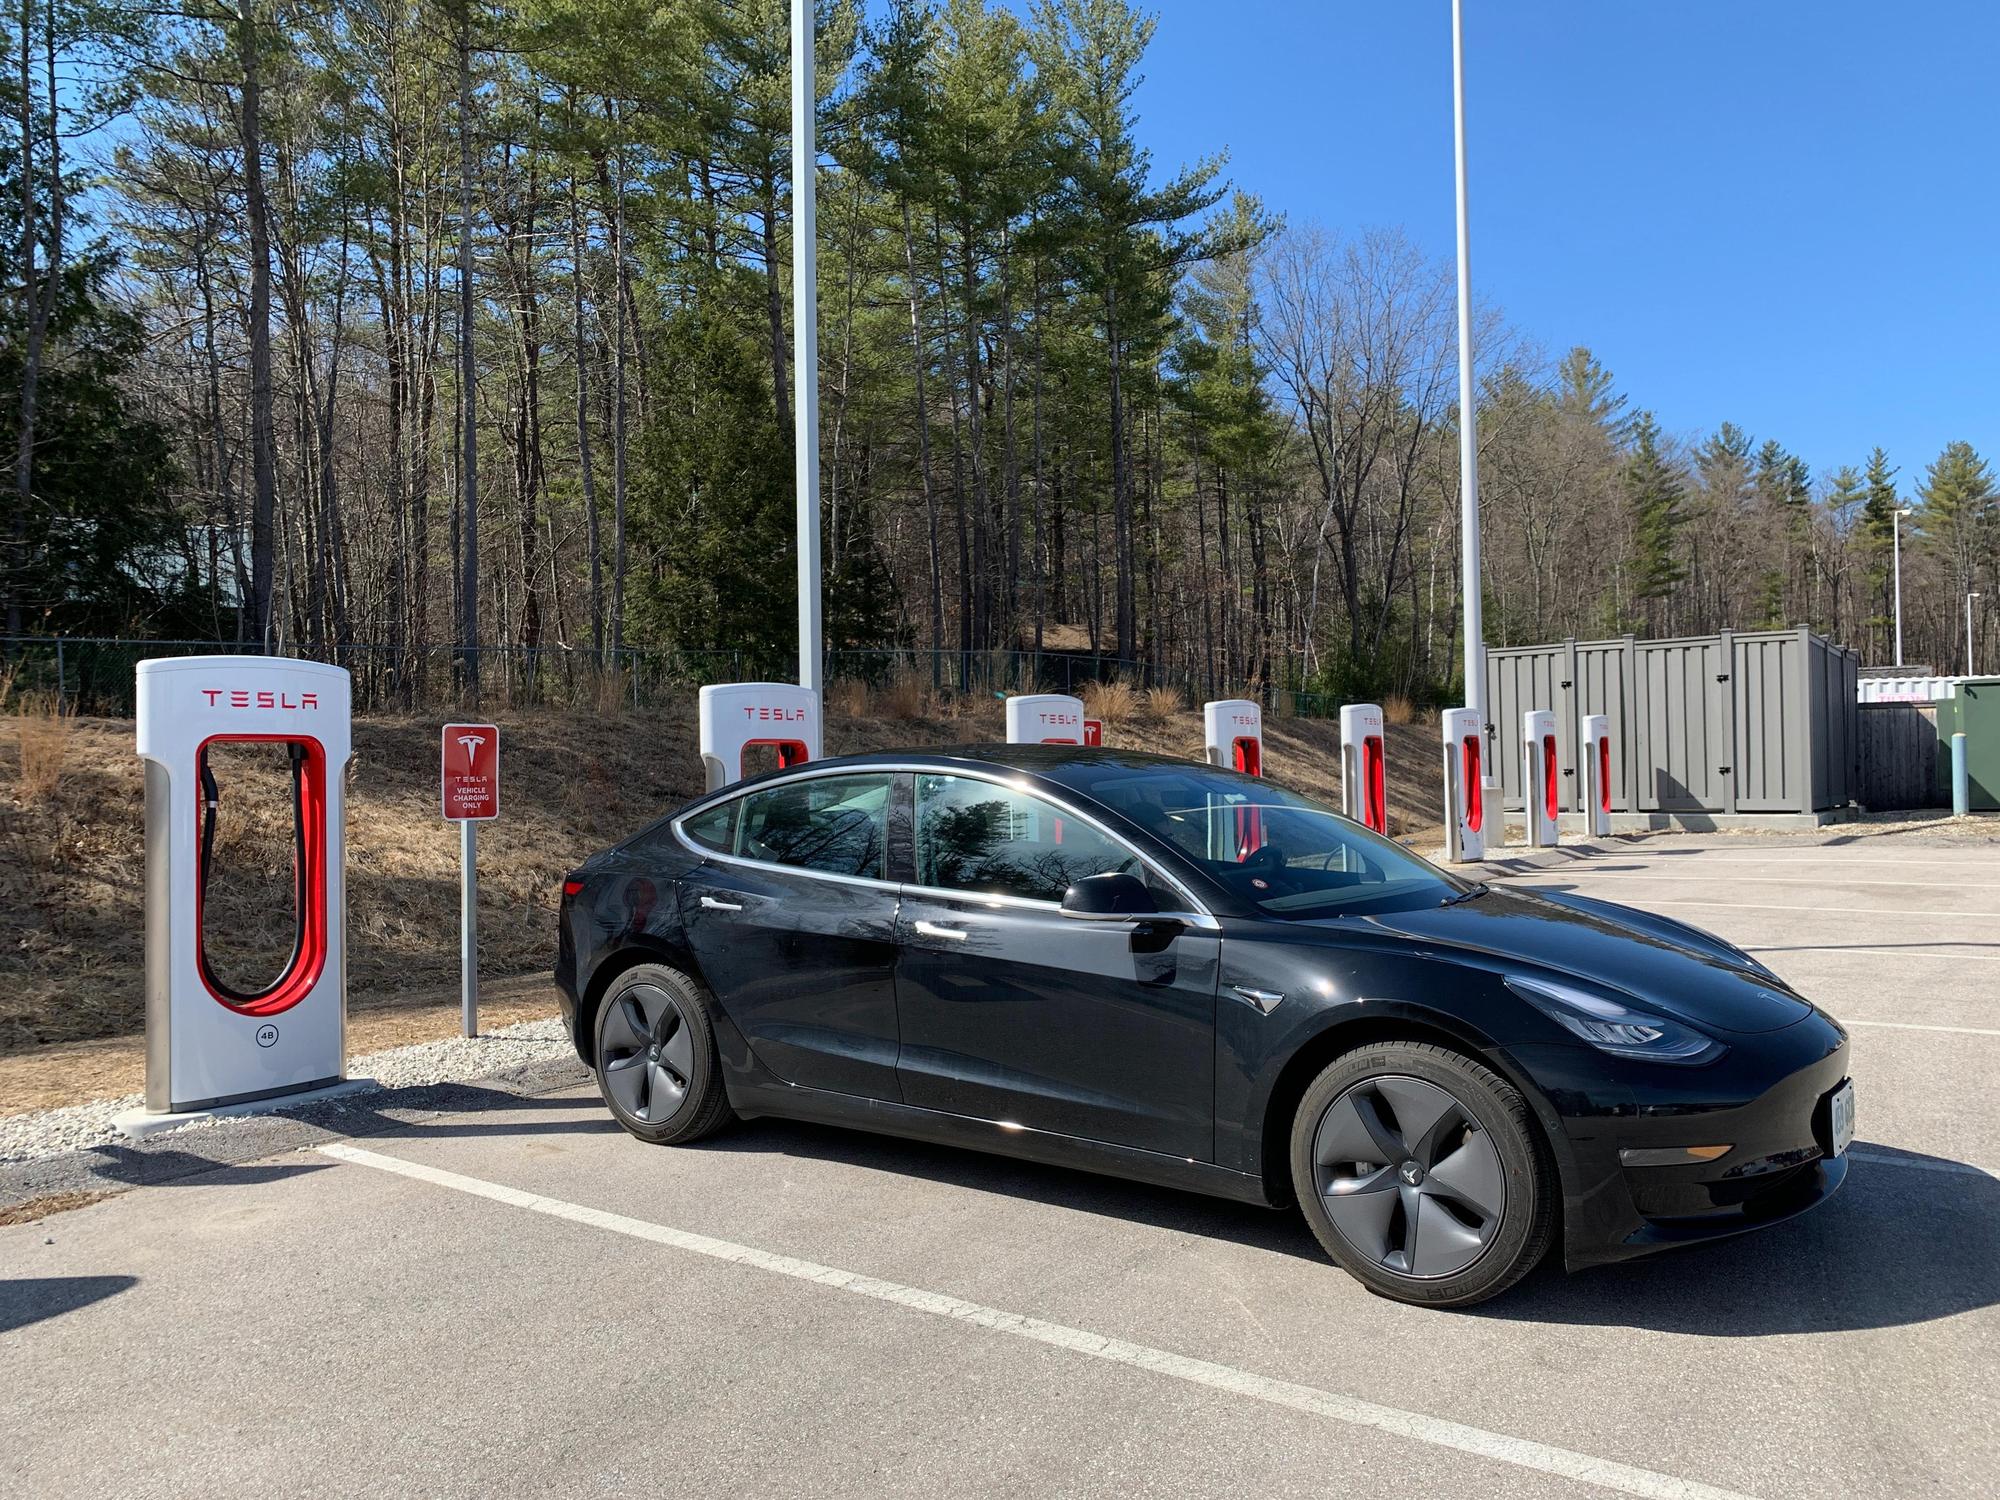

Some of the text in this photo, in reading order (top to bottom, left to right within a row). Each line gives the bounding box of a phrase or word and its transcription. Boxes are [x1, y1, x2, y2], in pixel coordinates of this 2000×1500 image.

[201, 689, 318, 710] TESLA
[743, 707, 805, 721] TESLA
[1039, 713, 1078, 725] TESLA
[261, 1031, 274, 1040] 4B
